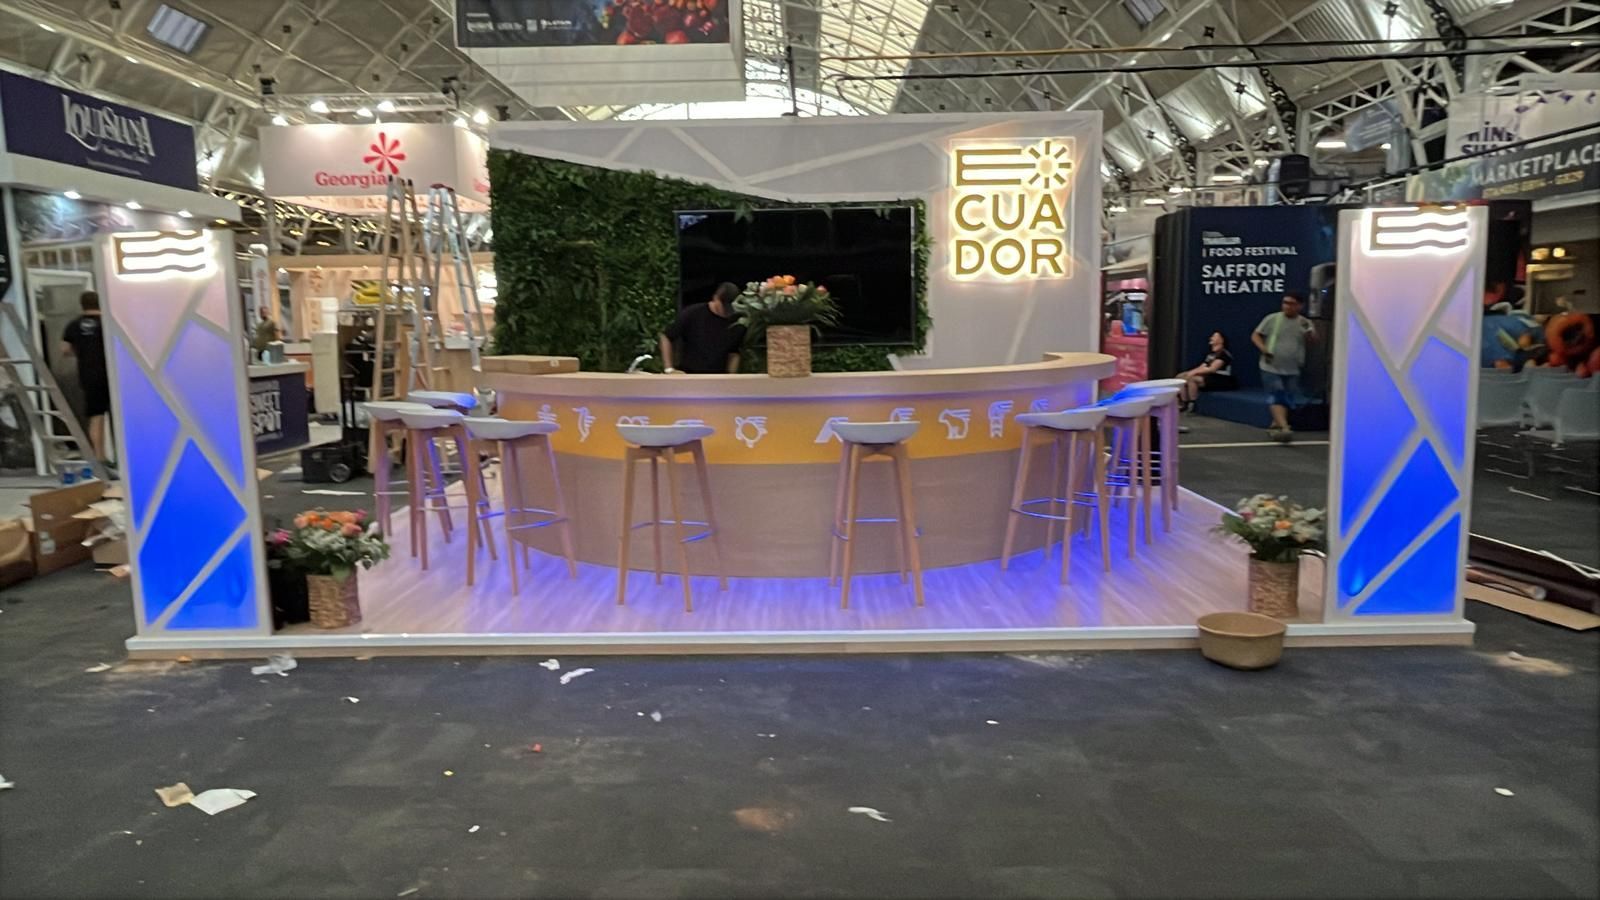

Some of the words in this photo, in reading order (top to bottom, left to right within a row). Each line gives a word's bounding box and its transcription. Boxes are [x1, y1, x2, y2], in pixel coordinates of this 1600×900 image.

[315, 171, 388, 189] Georgia
[955, 193, 1064, 231] CUA
[955, 238, 1063, 275] DOR
[1209, 247, 1243, 257] FOOD
[1244, 246, 1298, 256] FESTIVAL
[1202, 262, 1286, 278] SAFFRON
[1202, 279, 1285, 294] THEATRE
